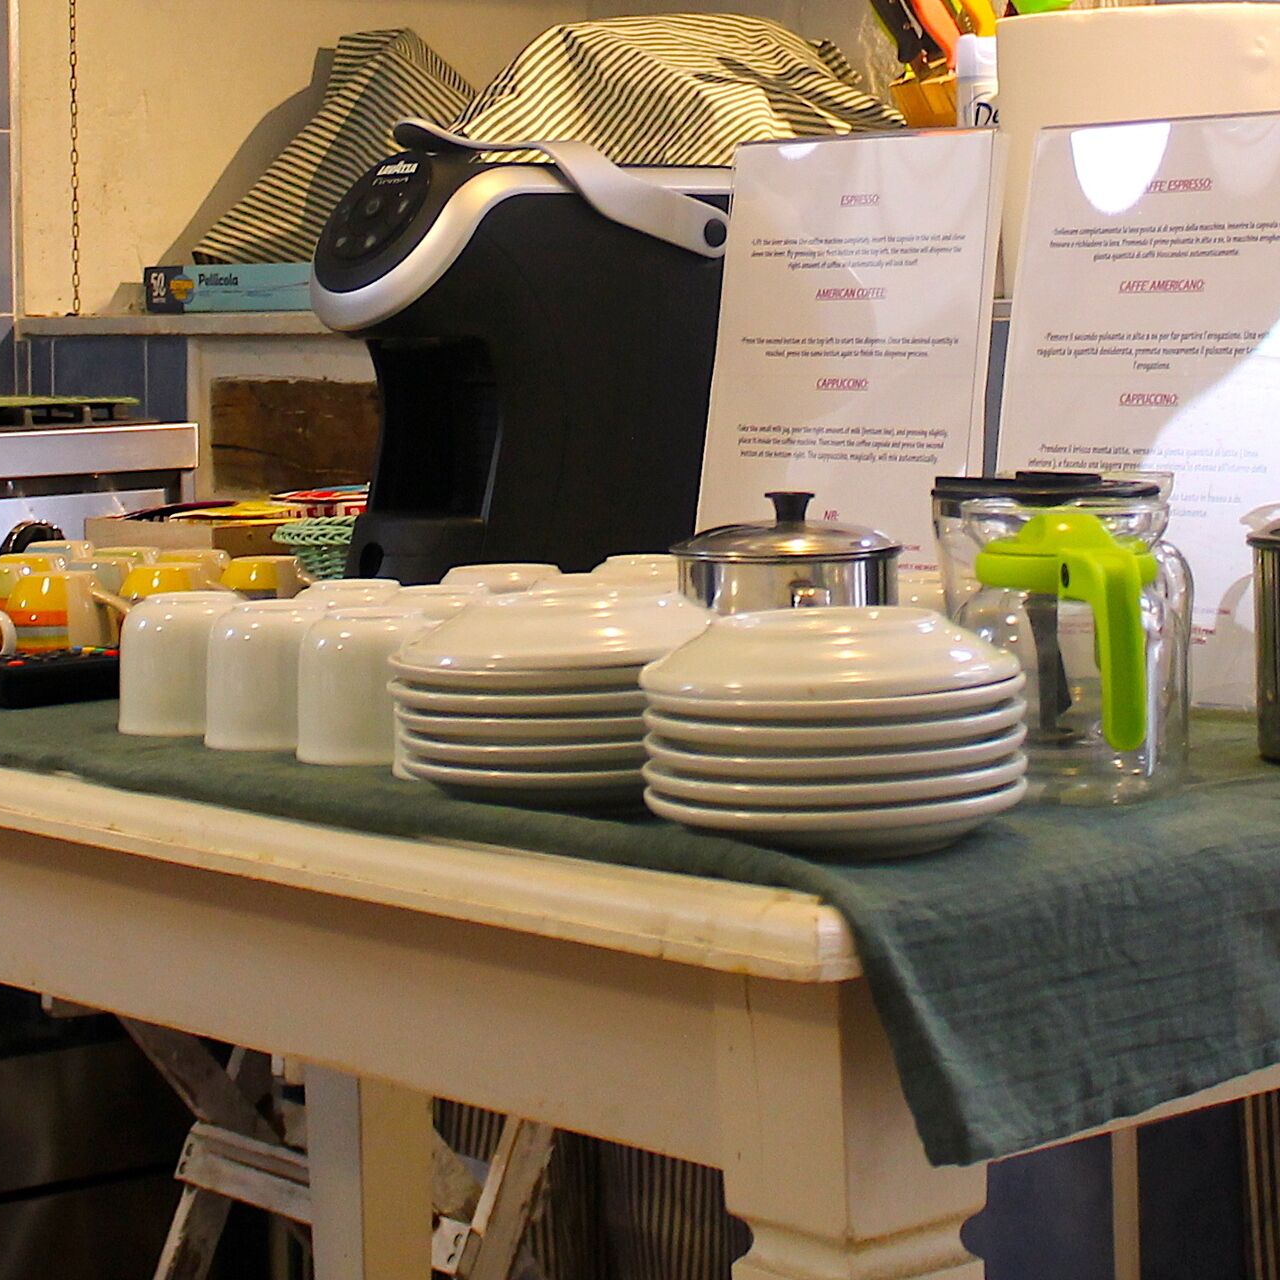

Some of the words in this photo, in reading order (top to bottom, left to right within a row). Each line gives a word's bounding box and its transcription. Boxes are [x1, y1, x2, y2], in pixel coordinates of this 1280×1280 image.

[376, 160, 419, 176] LAVAZZA
[1168, 178, 1212, 192] ESPRESSO:
[150, 272, 166, 296] 50
[198, 274, 238, 286] Pellicola
[1150, 279, 1205, 292] AMERICANO:
[816, 288, 855, 300] AMERICAN
[816, 378, 868, 390] CAPPUCCINO:
[1119, 392, 1178, 406] CAPPUCCINO:
